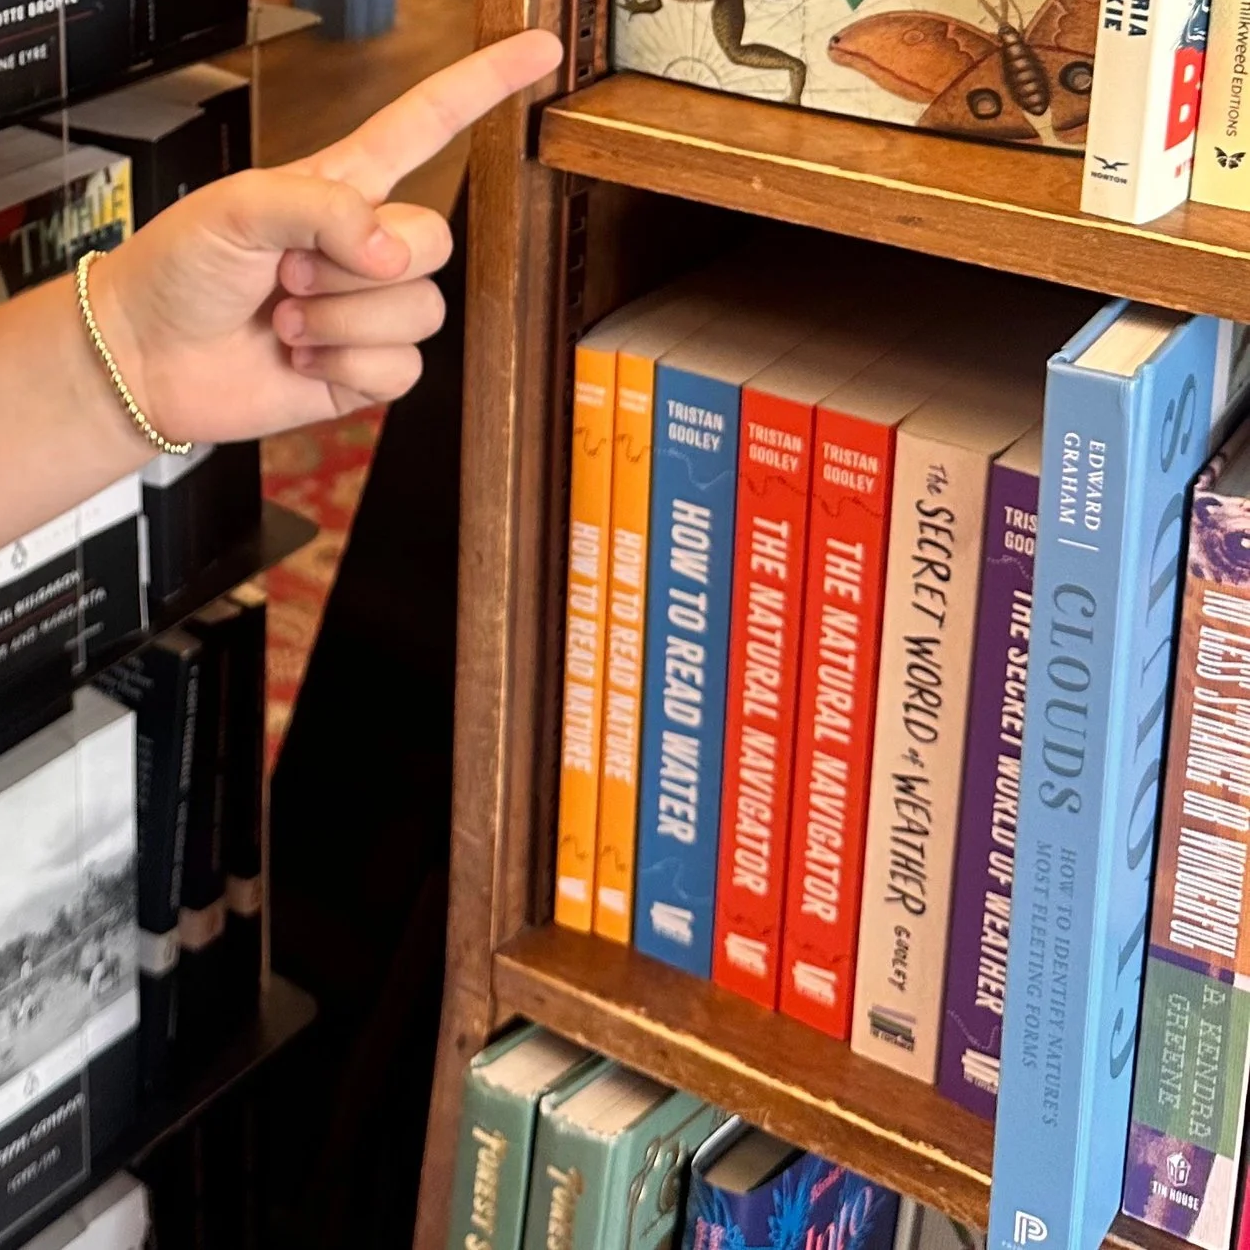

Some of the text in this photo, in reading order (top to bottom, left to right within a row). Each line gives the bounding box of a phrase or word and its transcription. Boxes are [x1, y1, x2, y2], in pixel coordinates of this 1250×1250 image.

[18, 43, 48, 68] EYRE
[1225, 76, 1243, 138] EDITIONS
[1090, 170, 1128, 185] NORTON
[667, 400, 724, 433] TRISTAN
[667, 422, 721, 452] GOOLEY
[748, 422, 803, 453] TRISTAN
[748, 445, 800, 474] GOOLEY
[823, 441, 879, 474] TRISTAN
[823, 463, 876, 494] GOOLEY
[925, 463, 949, 495] The
[1059, 431, 1081, 526] GRAHAM
[1084, 440, 1106, 532] EDWARD
[910, 498, 956, 630] SECRET
[1009, 589, 1032, 641] THE
[563, 520, 600, 774] HOW TO READ NATURE
[604, 528, 642, 786] HOW TO READ NATURE
[657, 498, 711, 844] HOW TO READ WATER
[901, 634, 944, 744] WORLD
[999, 642, 1030, 752] SECRET
[731, 515, 789, 897] THE NATURAL NAVIGATOR
[800, 536, 864, 924] THE NATURAL NAVIGATOR
[1038, 582, 1097, 815] CLOUDS
[885, 772, 932, 917] WEATHER
[1182, 790, 1250, 832] OR
[987, 849, 1014, 885] OF
[1168, 827, 1248, 959] WONDERFUL
[974, 889, 1010, 1016] WEATHER
[1021, 839, 1053, 1069] MOST FLEETING FORMS
[1042, 848, 1078, 1128] HOW TO IDENTIFY NATURE'S
[1156, 992, 1191, 1111] GREENE
[1188, 1015, 1223, 1139] KENDRA
[1152, 1179, 1200, 1212] TIN HOUSE
